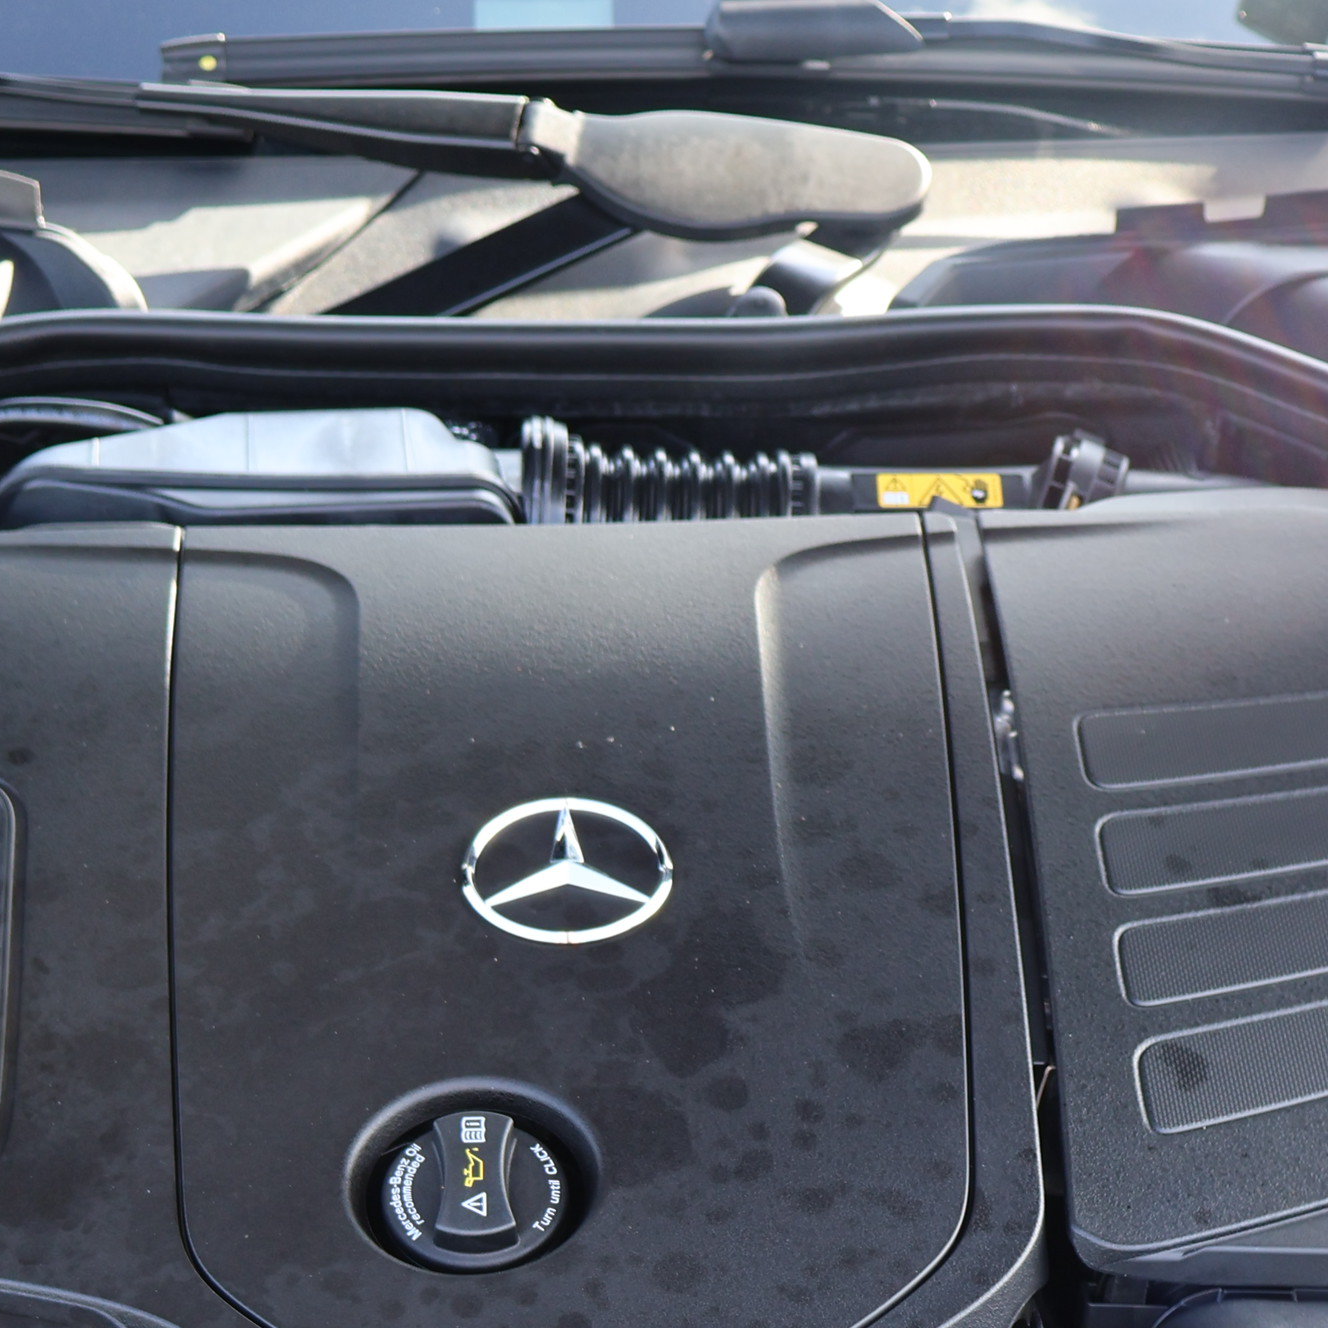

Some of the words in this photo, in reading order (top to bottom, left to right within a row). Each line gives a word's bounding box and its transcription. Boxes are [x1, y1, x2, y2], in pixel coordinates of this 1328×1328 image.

[405, 1143, 422, 1158] Oil
[529, 1143, 558, 1176] CLICK
[389, 1155, 423, 1242] Mercedes-Benz
[401, 1154, 426, 1226] recommended
[546, 1180, 562, 1205] until
[532, 1206, 557, 1233] Turn
